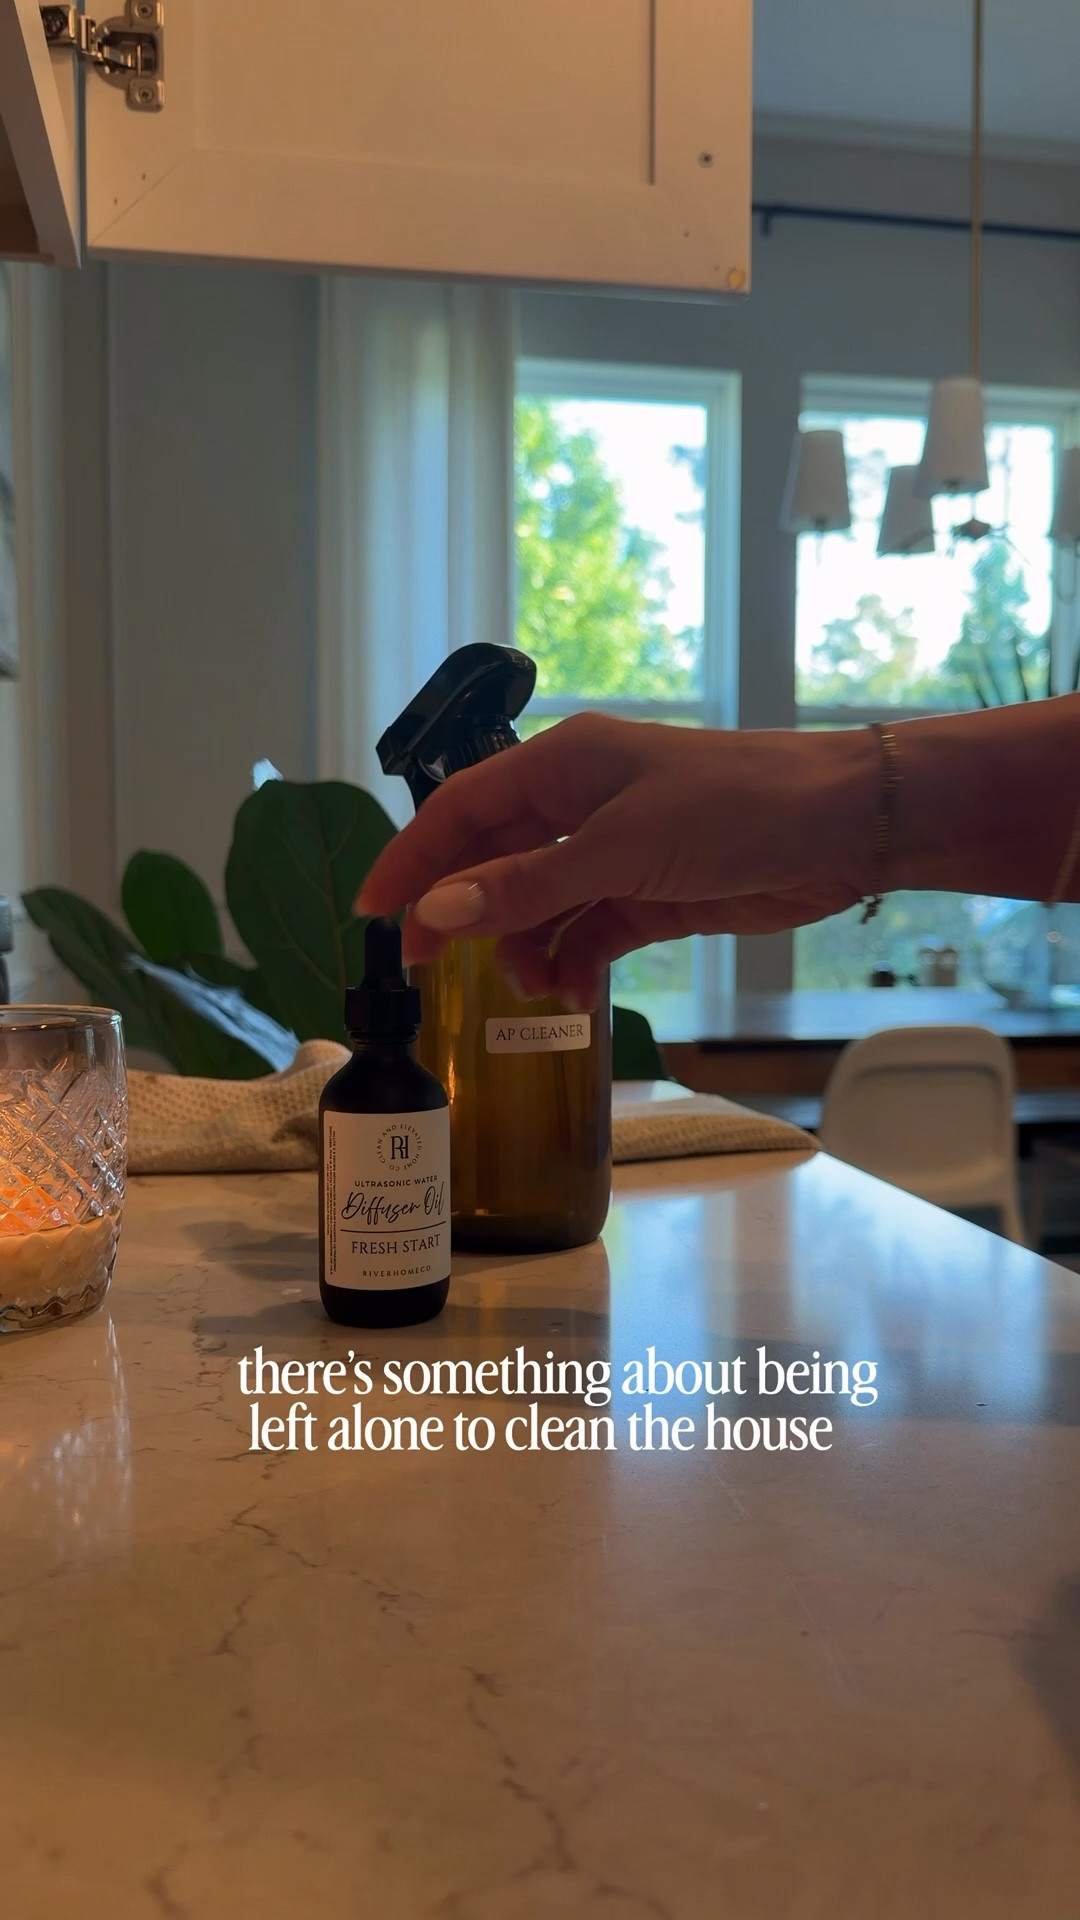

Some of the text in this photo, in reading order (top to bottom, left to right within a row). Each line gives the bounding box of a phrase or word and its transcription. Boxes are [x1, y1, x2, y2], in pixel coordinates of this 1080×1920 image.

[496, 1024, 584, 1040] AP CLEANER
[382, 1124, 397, 1138] AND
[354, 1174, 438, 1188] ULTRASONIC WATER
[341, 1192, 420, 1226] Diffuser
[424, 1181, 445, 1216] Oil
[351, 1234, 441, 1255] FRESH START
[362, 1265, 431, 1277] RIVERHOMECO
